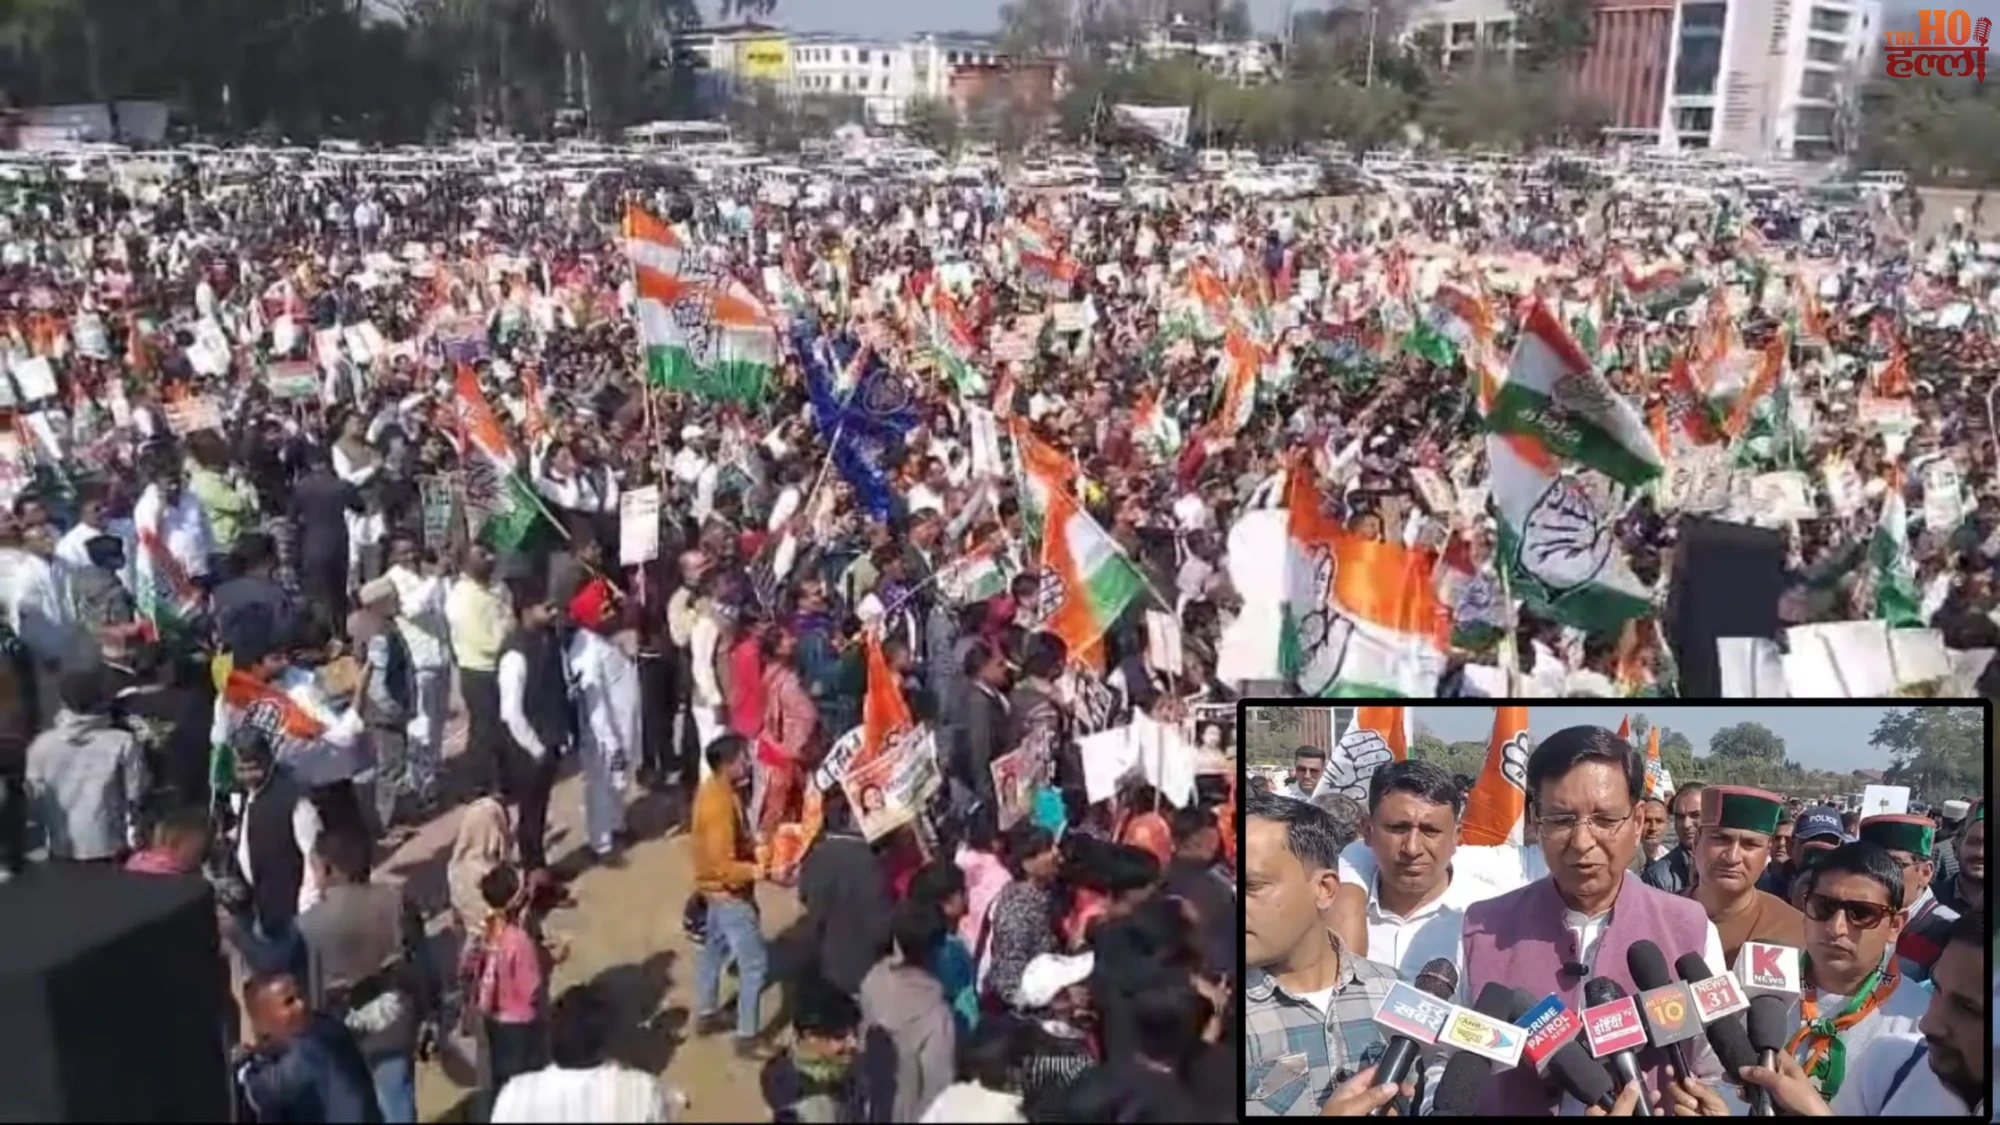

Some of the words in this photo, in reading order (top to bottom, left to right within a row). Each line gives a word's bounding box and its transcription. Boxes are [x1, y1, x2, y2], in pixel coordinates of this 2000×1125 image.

[1809, 814, 1838, 826] POLICE
[1753, 945, 1786, 977] K
[1698, 977, 1728, 993] NEWS
[1754, 974, 1786, 986] NEWS
[1707, 989, 1731, 1007] 31
[1526, 1006, 1559, 1038] CRIME
[1654, 1001, 1684, 1025] 10
[1527, 1014, 1571, 1051] PATROL
[1550, 1021, 1572, 1042] NEWS
